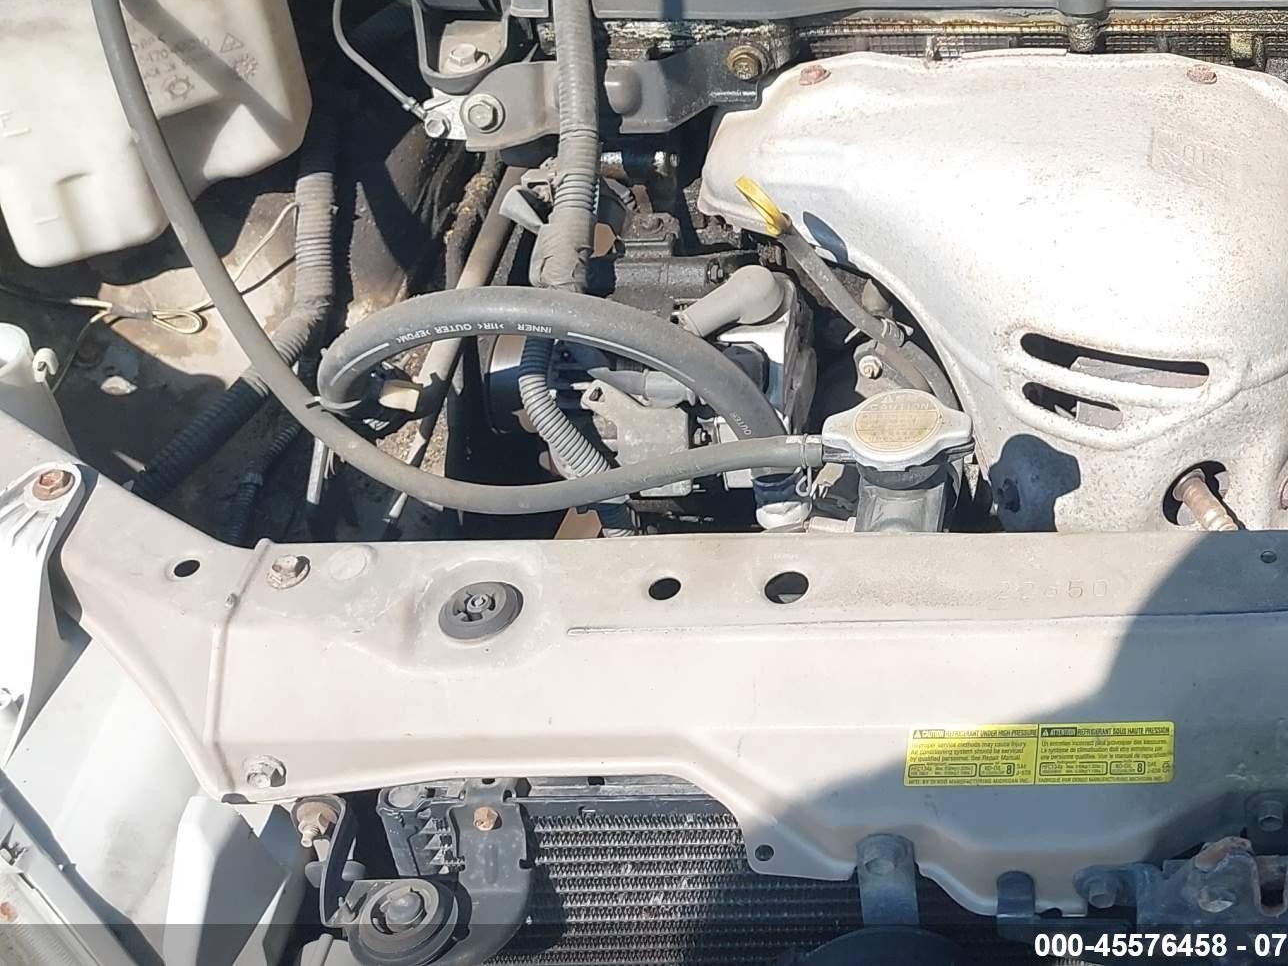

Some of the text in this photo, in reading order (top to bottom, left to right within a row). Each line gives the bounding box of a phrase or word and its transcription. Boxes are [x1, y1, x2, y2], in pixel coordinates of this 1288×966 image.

[433, 322, 473, 334] OUTER
[517, 323, 553, 334] INNER
[1006, 765, 1012, 775] 8
[1136, 762, 1143, 773] 8
